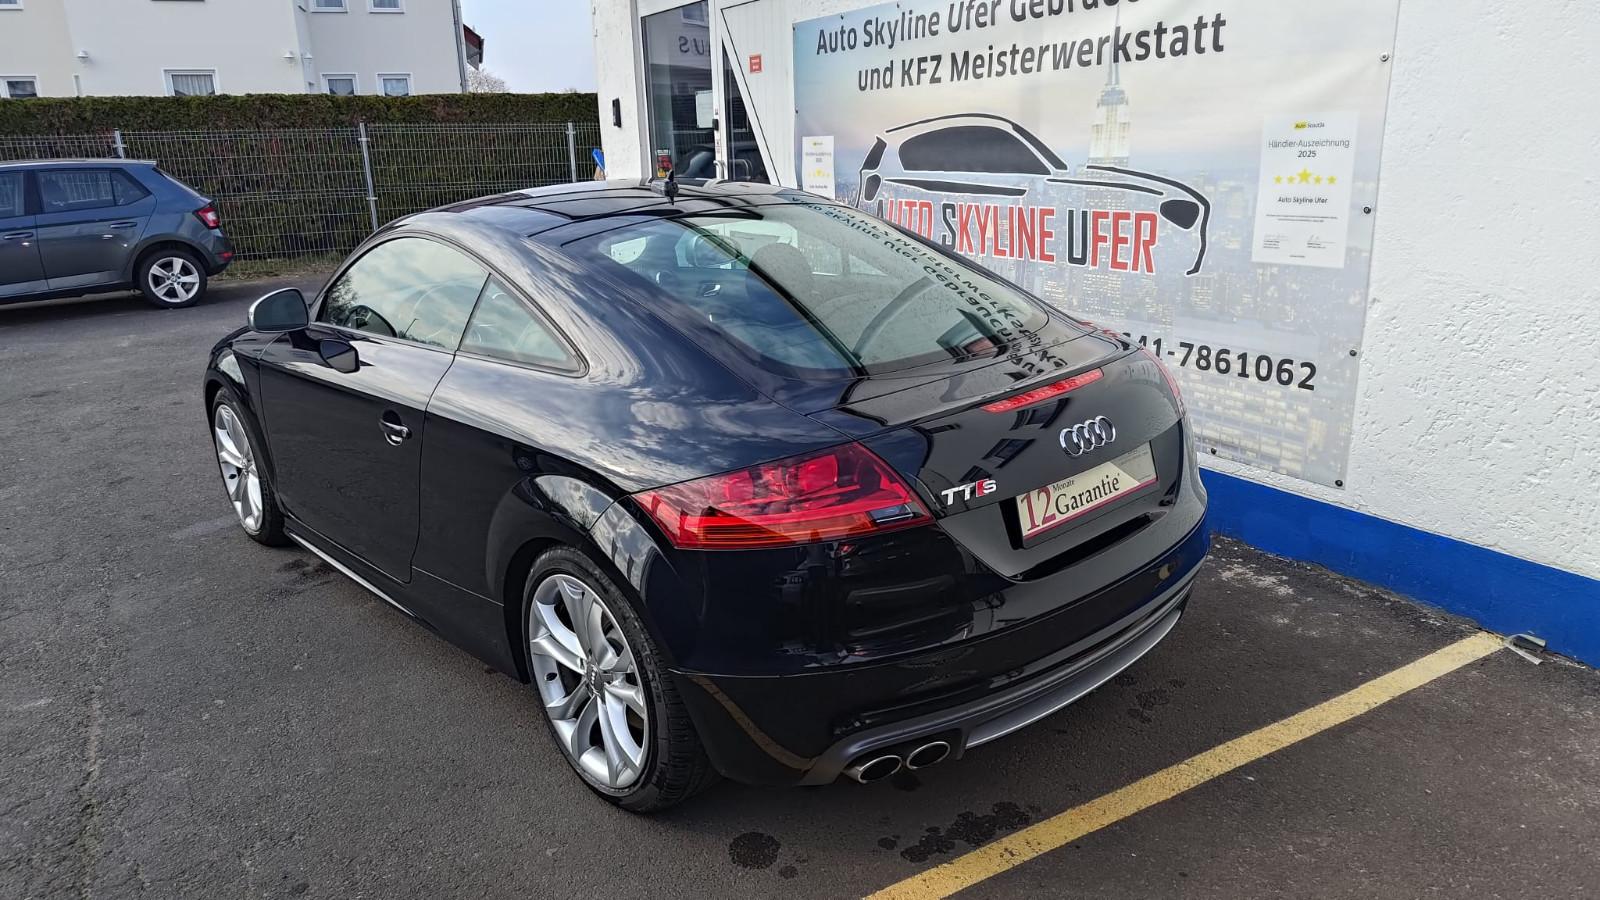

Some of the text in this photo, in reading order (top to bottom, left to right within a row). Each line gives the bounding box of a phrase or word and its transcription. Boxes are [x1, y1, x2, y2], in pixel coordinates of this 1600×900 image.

[816, 25, 857, 55] Auto
[863, 10, 940, 49] Skyline
[947, 0, 1001, 33] Ufer
[858, 13, 1227, 91] und KFZ Meisterwerkstatt
[1268, 139, 1350, 149] Händler-Auszeichnung
[1297, 150, 1317, 158] 2025
[1292, 196, 1313, 204] Skyline
[941, 203, 1055, 263] SKYLINE
[1067, 209, 1158, 274] UFER
[1123, 332, 1316, 391] 1-7861062
[1021, 475, 1119, 532] 12 Garantie
